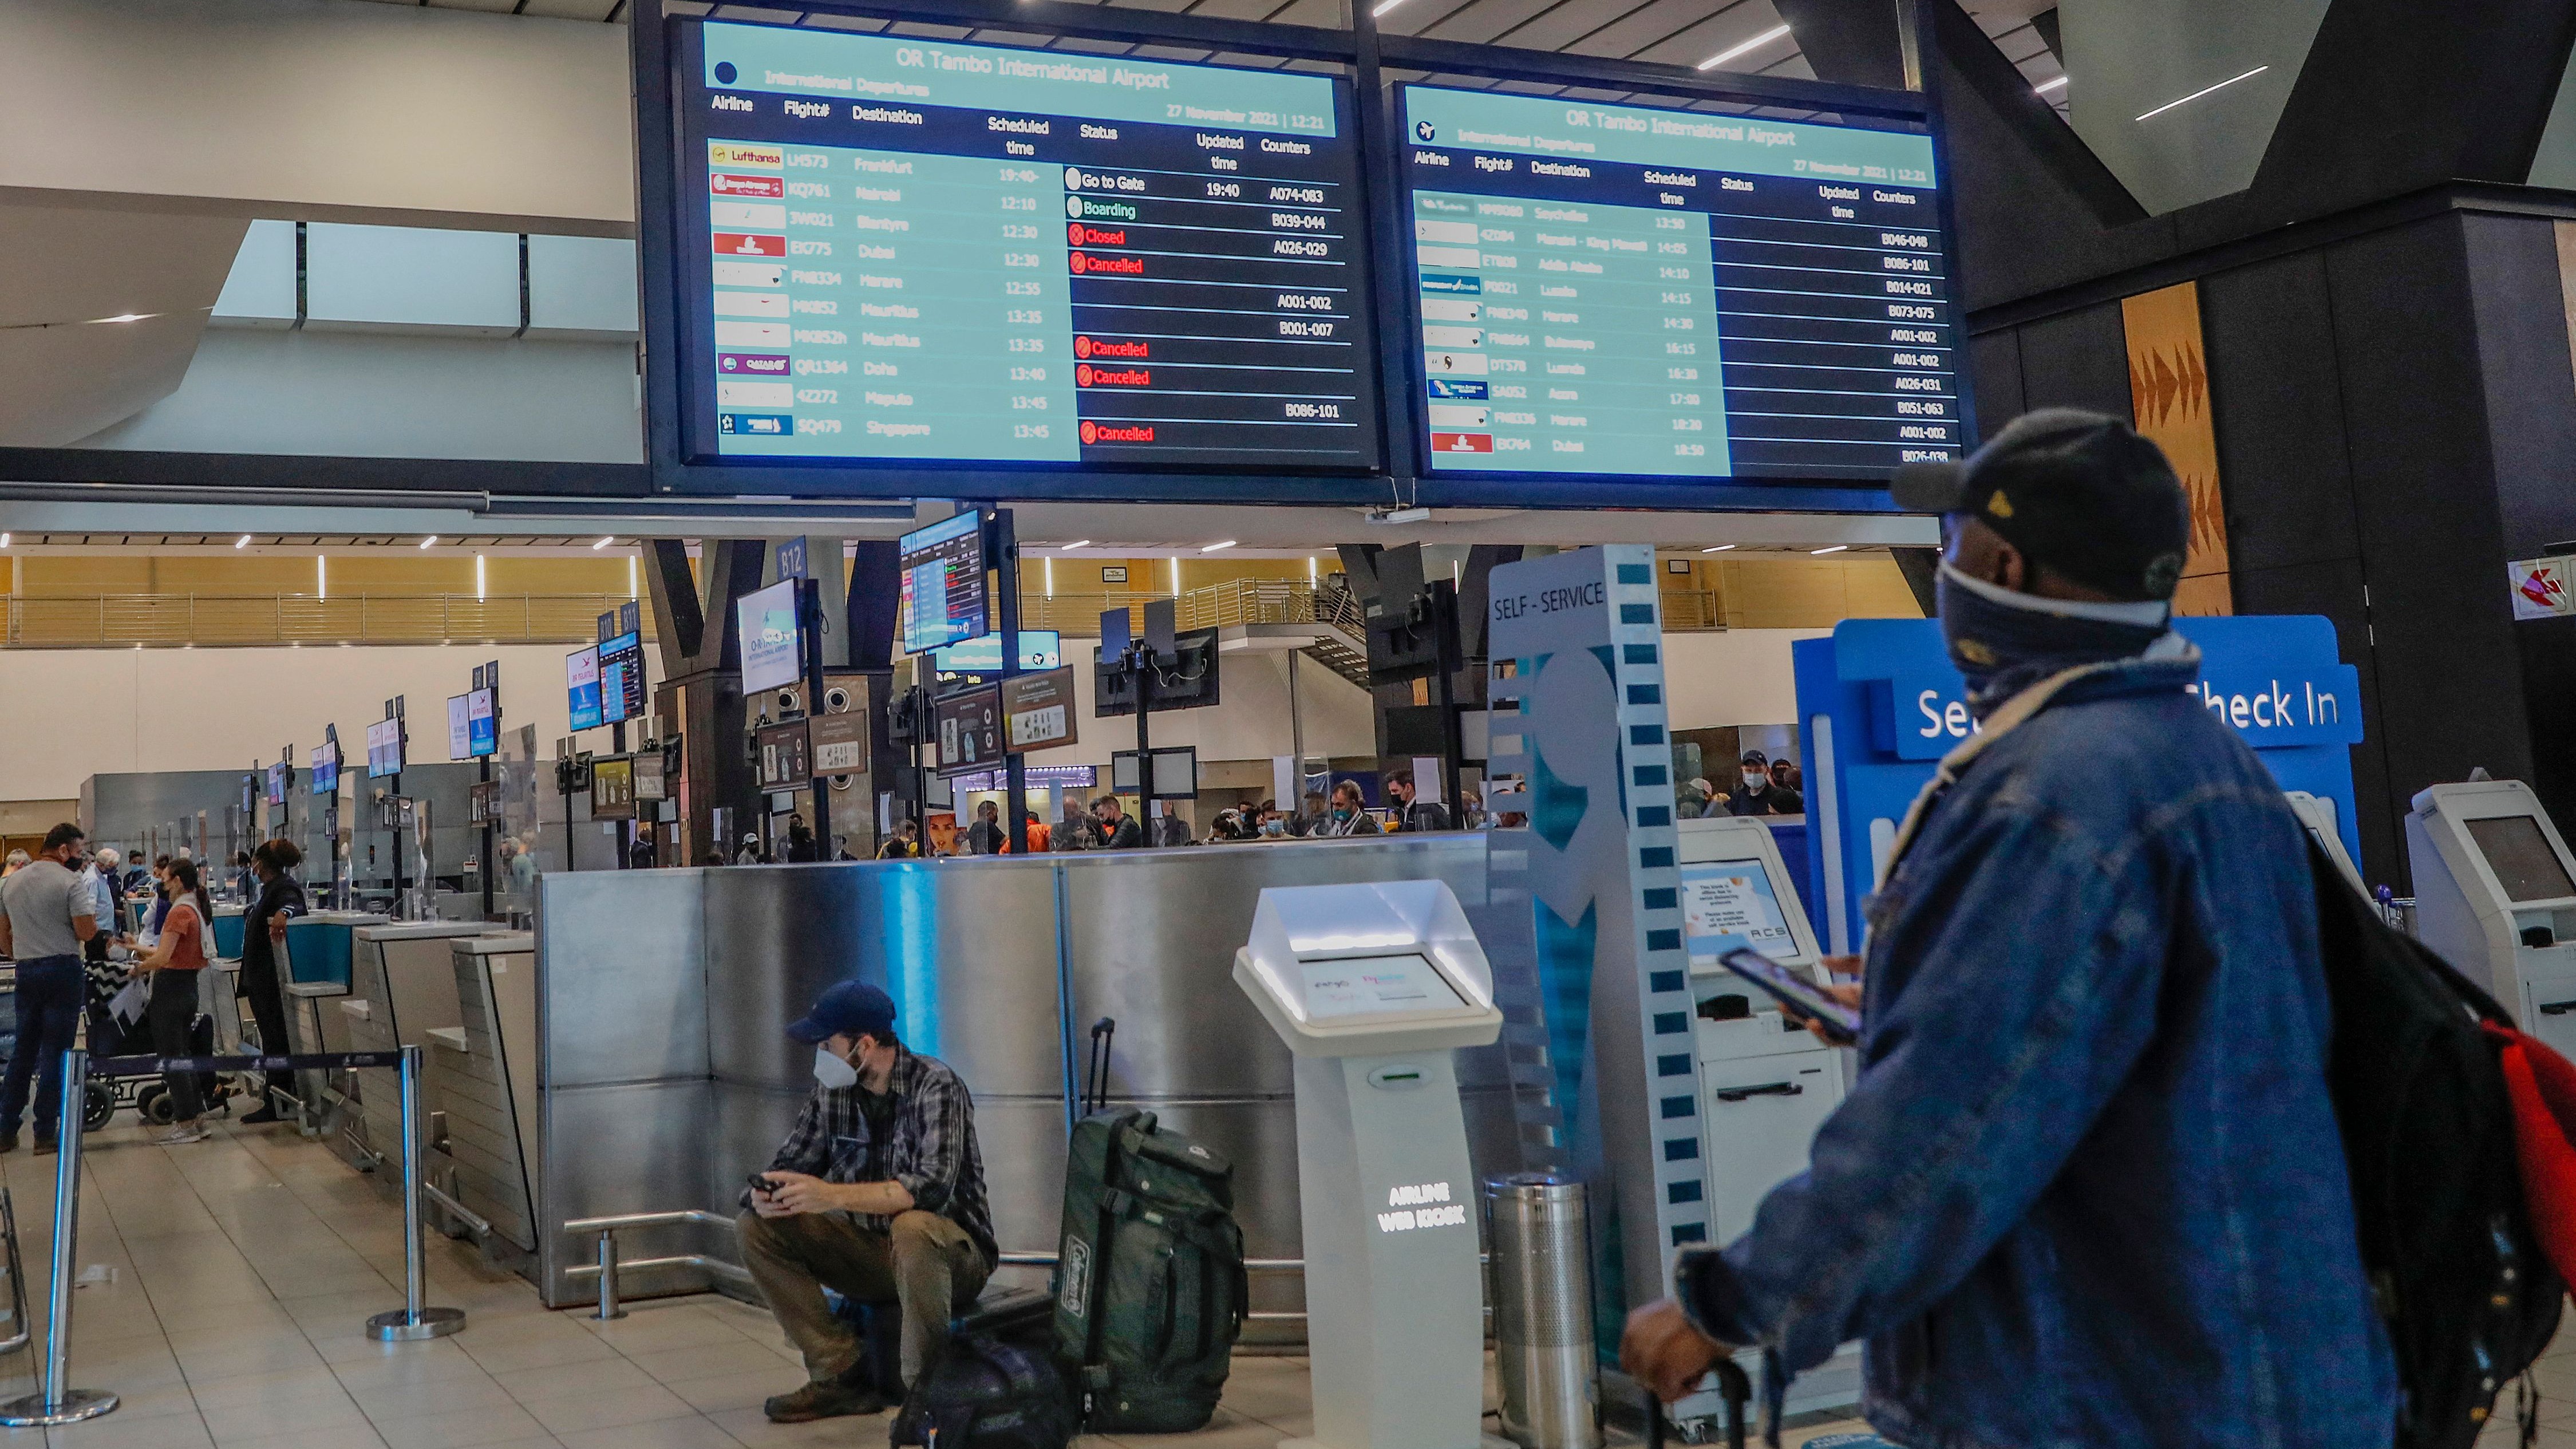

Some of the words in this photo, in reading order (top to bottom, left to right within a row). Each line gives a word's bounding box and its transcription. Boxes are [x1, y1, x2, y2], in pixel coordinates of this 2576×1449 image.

[896, 48, 924, 68] OR
[930, 50, 992, 73] Tambo
[998, 57, 1107, 84] International
[1112, 68, 1169, 90] Airport
[765, 70, 852, 90] International
[857, 78, 930, 97] Departures
[712, 95, 753, 111] Airline
[784, 101, 830, 118] Flight#
[853, 106, 922, 124] Destination
[1167, 104, 1182, 117] 27
[1186, 106, 1246, 122] November
[1249, 111, 1278, 125] 2021
[1292, 115, 1324, 129] 12:21
[988, 117, 1049, 134] Scheduled
[1080, 124, 1117, 139] Status
[1567, 110, 1590, 127] OR
[1594, 112, 1647, 132] Tambo
[1652, 117, 1743, 140] International
[1748, 127, 1796, 146] Airport
[1006, 141, 1034, 155] time
[1197, 133, 1243, 149] Updated
[1261, 139, 1311, 154] Counters
[1458, 129, 1531, 147] International
[1534, 136, 1595, 153] Departures
[732, 151, 780, 165] Lufthansa
[1211, 156, 1237, 170] time
[1415, 151, 1449, 165] Airline
[1475, 156, 1513, 172] Flight#
[1532, 161, 1590, 177] Destination
[1793, 159, 1807, 171] 27
[1809, 161, 1859, 175] November
[1082, 174, 1099, 187] Go
[1101, 175, 1115, 188] to
[1117, 176, 1145, 191] Gate
[1645, 171, 1696, 186] Scheduled
[1721, 178, 1753, 191] Status
[1207, 183, 1239, 197] 19:40
[1270, 187, 1323, 203] A074-083
[1819, 185, 1859, 199] Updated
[1874, 191, 1915, 204] Counters
[1002, 196, 1036, 210] 12:10
[1660, 192, 1684, 205] time
[1084, 202, 1136, 219] Boarding
[1832, 206, 1854, 218] time
[1273, 214, 1325, 229] B039-044
[1003, 225, 1038, 239] 12:30
[1084, 228, 1125, 244] Closed
[1274, 240, 1327, 255] A026-029
[1882, 234, 1927, 247] B046-048
[1005, 253, 1039, 267] 12:30
[1085, 255, 1143, 273] Cancelled
[1884, 257, 1930, 271] B086-101
[1007, 282, 1041, 295] 12:55
[1886, 281, 1932, 295] B014-021
[1278, 295, 1332, 310] A001-002
[1008, 310, 1042, 323] 13:35
[1888, 305, 1934, 318] B073-075
[1280, 322, 1333, 336] B001-007
[1891, 330, 1937, 342] A001-002
[1009, 338, 1044, 352] 13:35
[1092, 341, 1149, 358] Cancelled
[1894, 353, 1939, 366] A001-002
[1011, 367, 1046, 381] 13:40
[1092, 368, 1150, 385] Cancelled
[1896, 377, 1941, 390] A026-031
[1013, 396, 1047, 409] 13:45
[1898, 402, 1943, 414] B051-063
[1286, 404, 1339, 417] B086-101
[798, 418, 841, 435] SQ479
[1015, 425, 1049, 438] 13:45
[1096, 425, 1153, 441] Cancelled
[1901, 427, 1946, 439] A001-002
[781, 545, 801, 576] B12
[1495, 595, 1527, 620] SELF
[1541, 582, 1603, 613] SERVICE
[623, 607, 637, 631] B11
[600, 618, 611, 641] B10
[2305, 681, 2339, 725] In
[1389, 1182, 1451, 1207] AIRLINE
[1377, 1210, 1416, 1233] WEB
[1416, 1205, 1466, 1229] KIOSK
